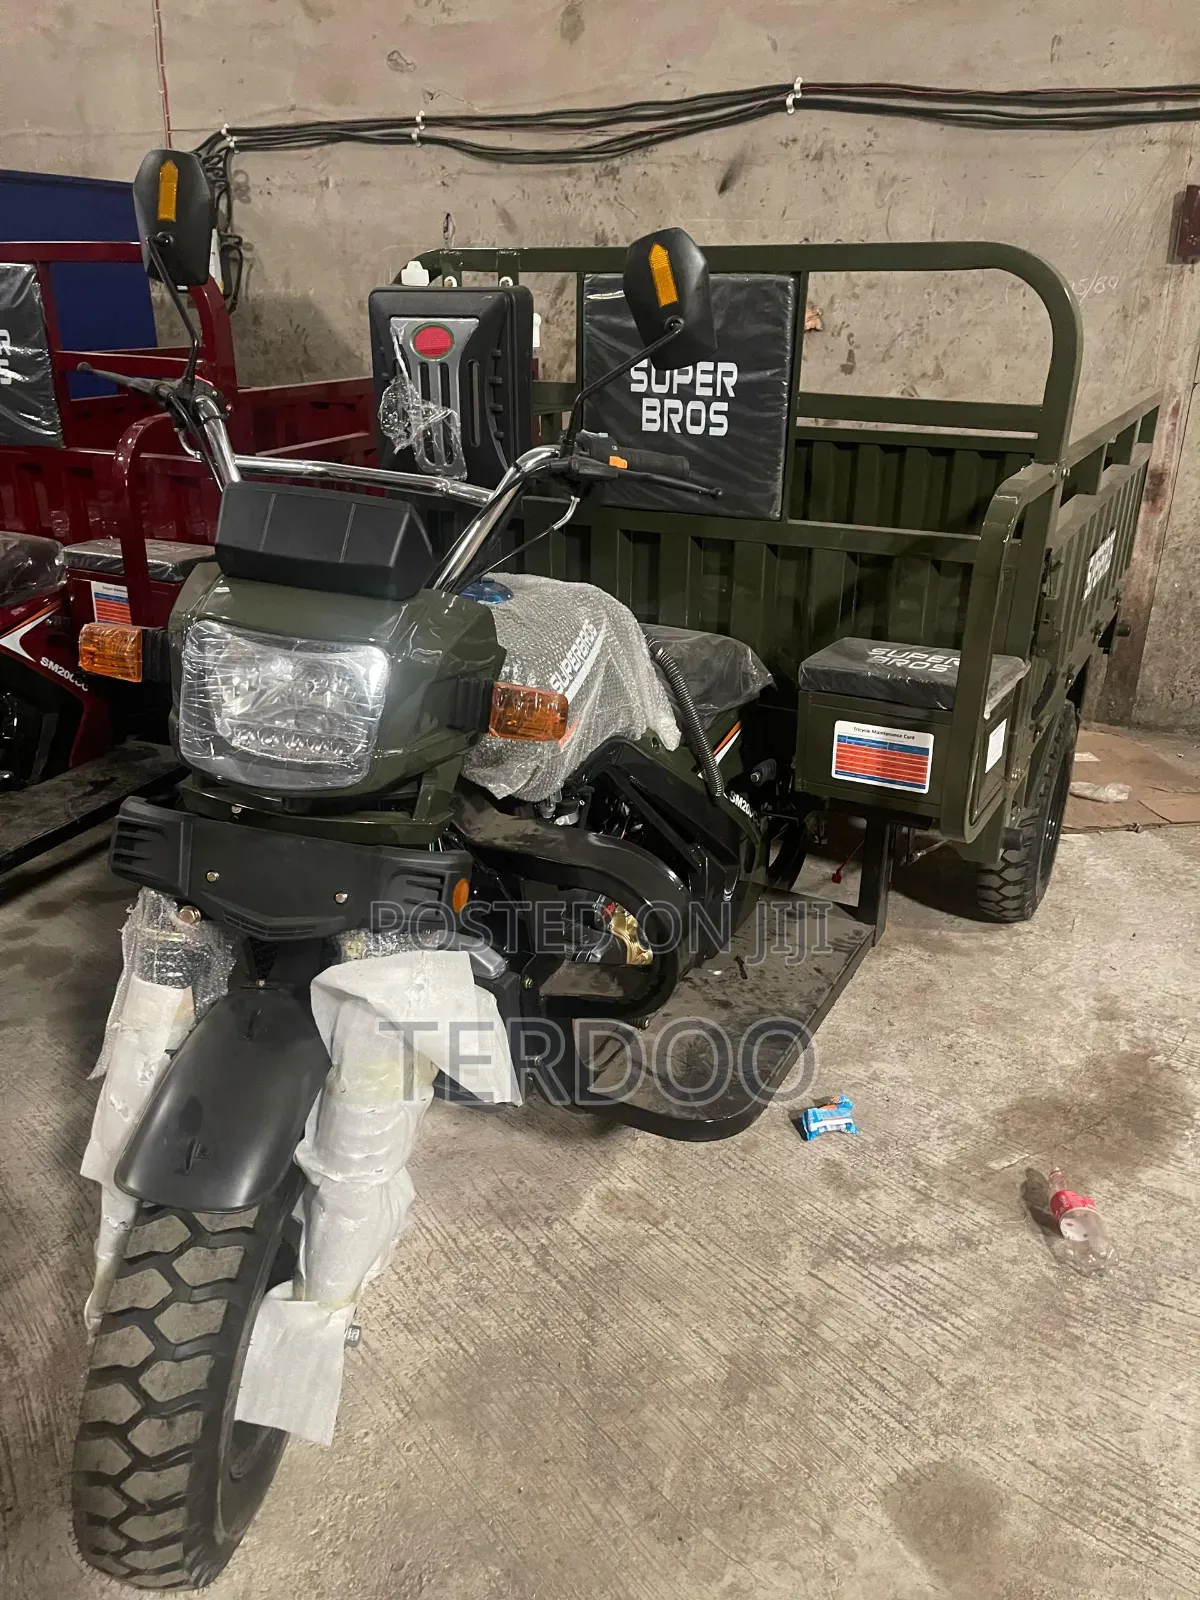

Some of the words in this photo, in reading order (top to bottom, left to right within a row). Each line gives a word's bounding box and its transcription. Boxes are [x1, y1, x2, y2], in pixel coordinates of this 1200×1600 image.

[630, 358, 738, 397] SUPER
[642, 397, 729, 436] BROS
[549, 619, 597, 694] SUPERBROS
[867, 648, 961, 666] SUPER
[867, 655, 952, 673] BROS
